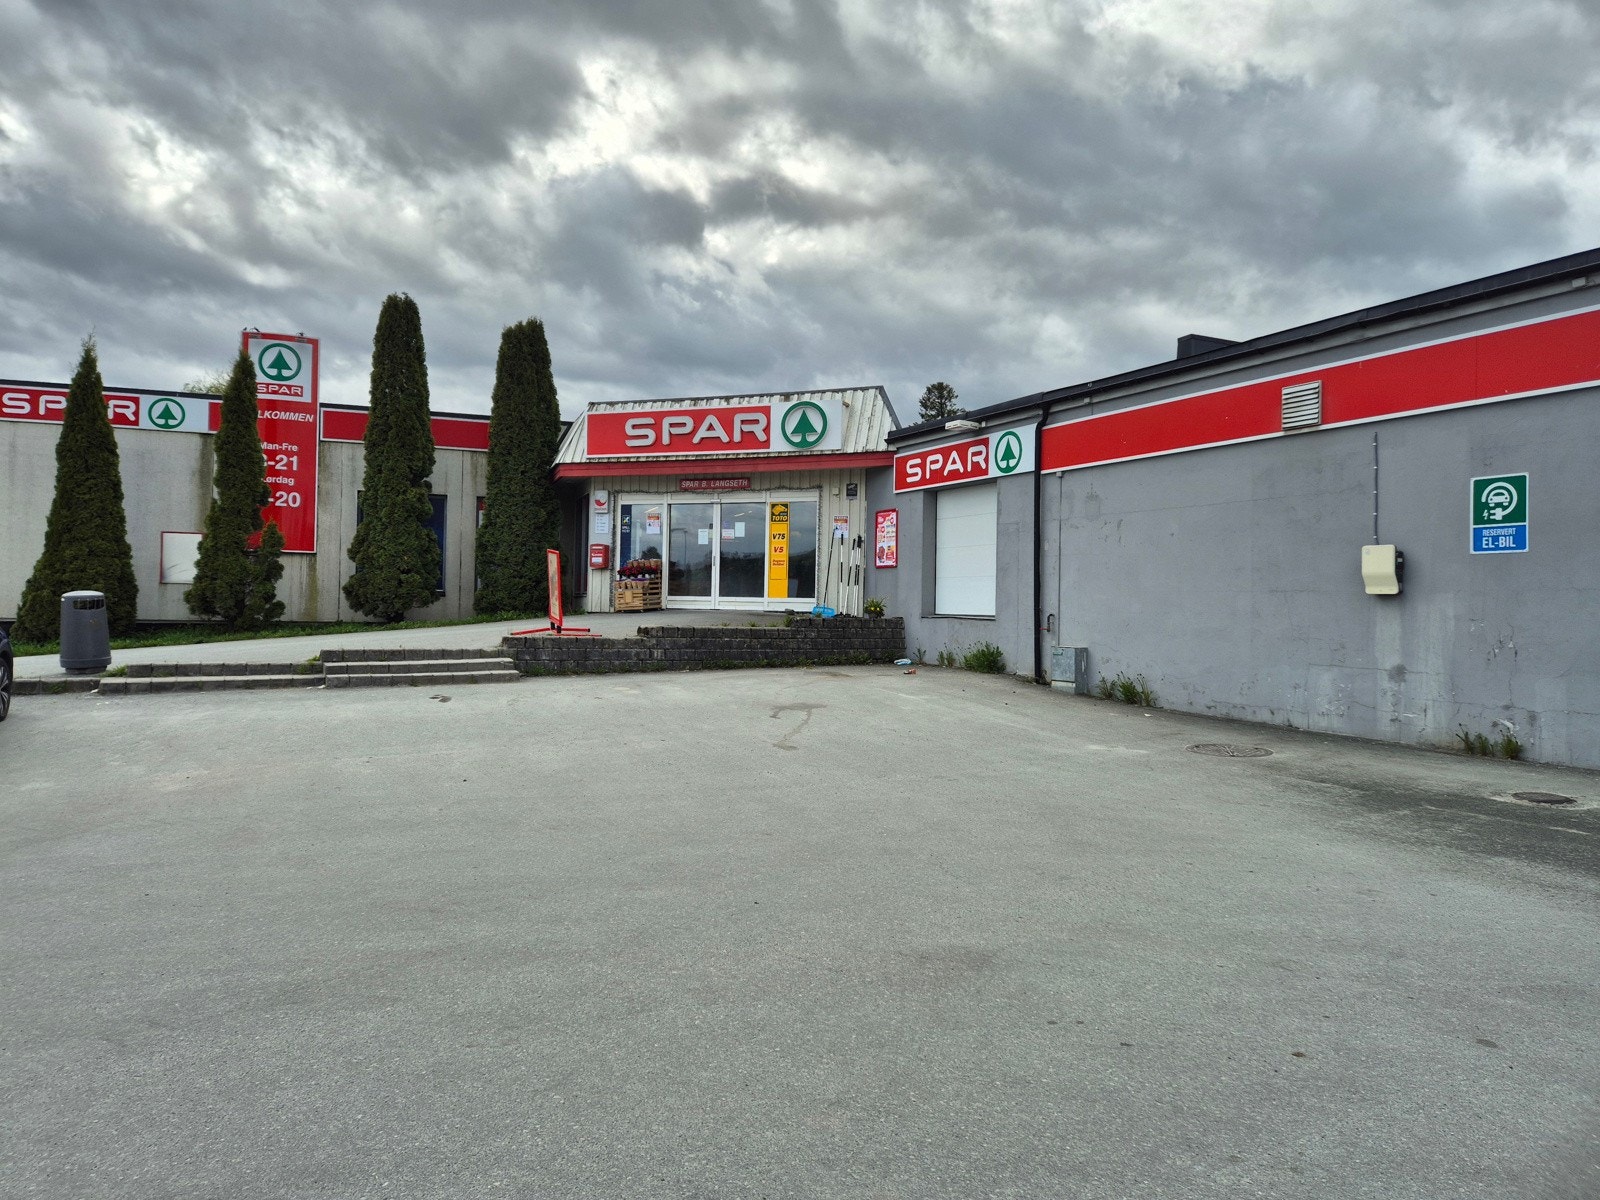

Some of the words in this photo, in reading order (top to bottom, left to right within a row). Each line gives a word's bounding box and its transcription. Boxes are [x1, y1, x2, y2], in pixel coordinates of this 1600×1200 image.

[257, 383, 302, 396] SPAR
[2, 393, 136, 421] SPR
[624, 412, 768, 447] SPAR
[906, 444, 987, 483] SPAR
[681, 480, 699, 488] SPAR
[710, 479, 748, 487] LANGSETH
[1482, 527, 1516, 537] RESERVERT
[1482, 536, 1516, 548] EL-BIL
[773, 545, 784, 553] V5
